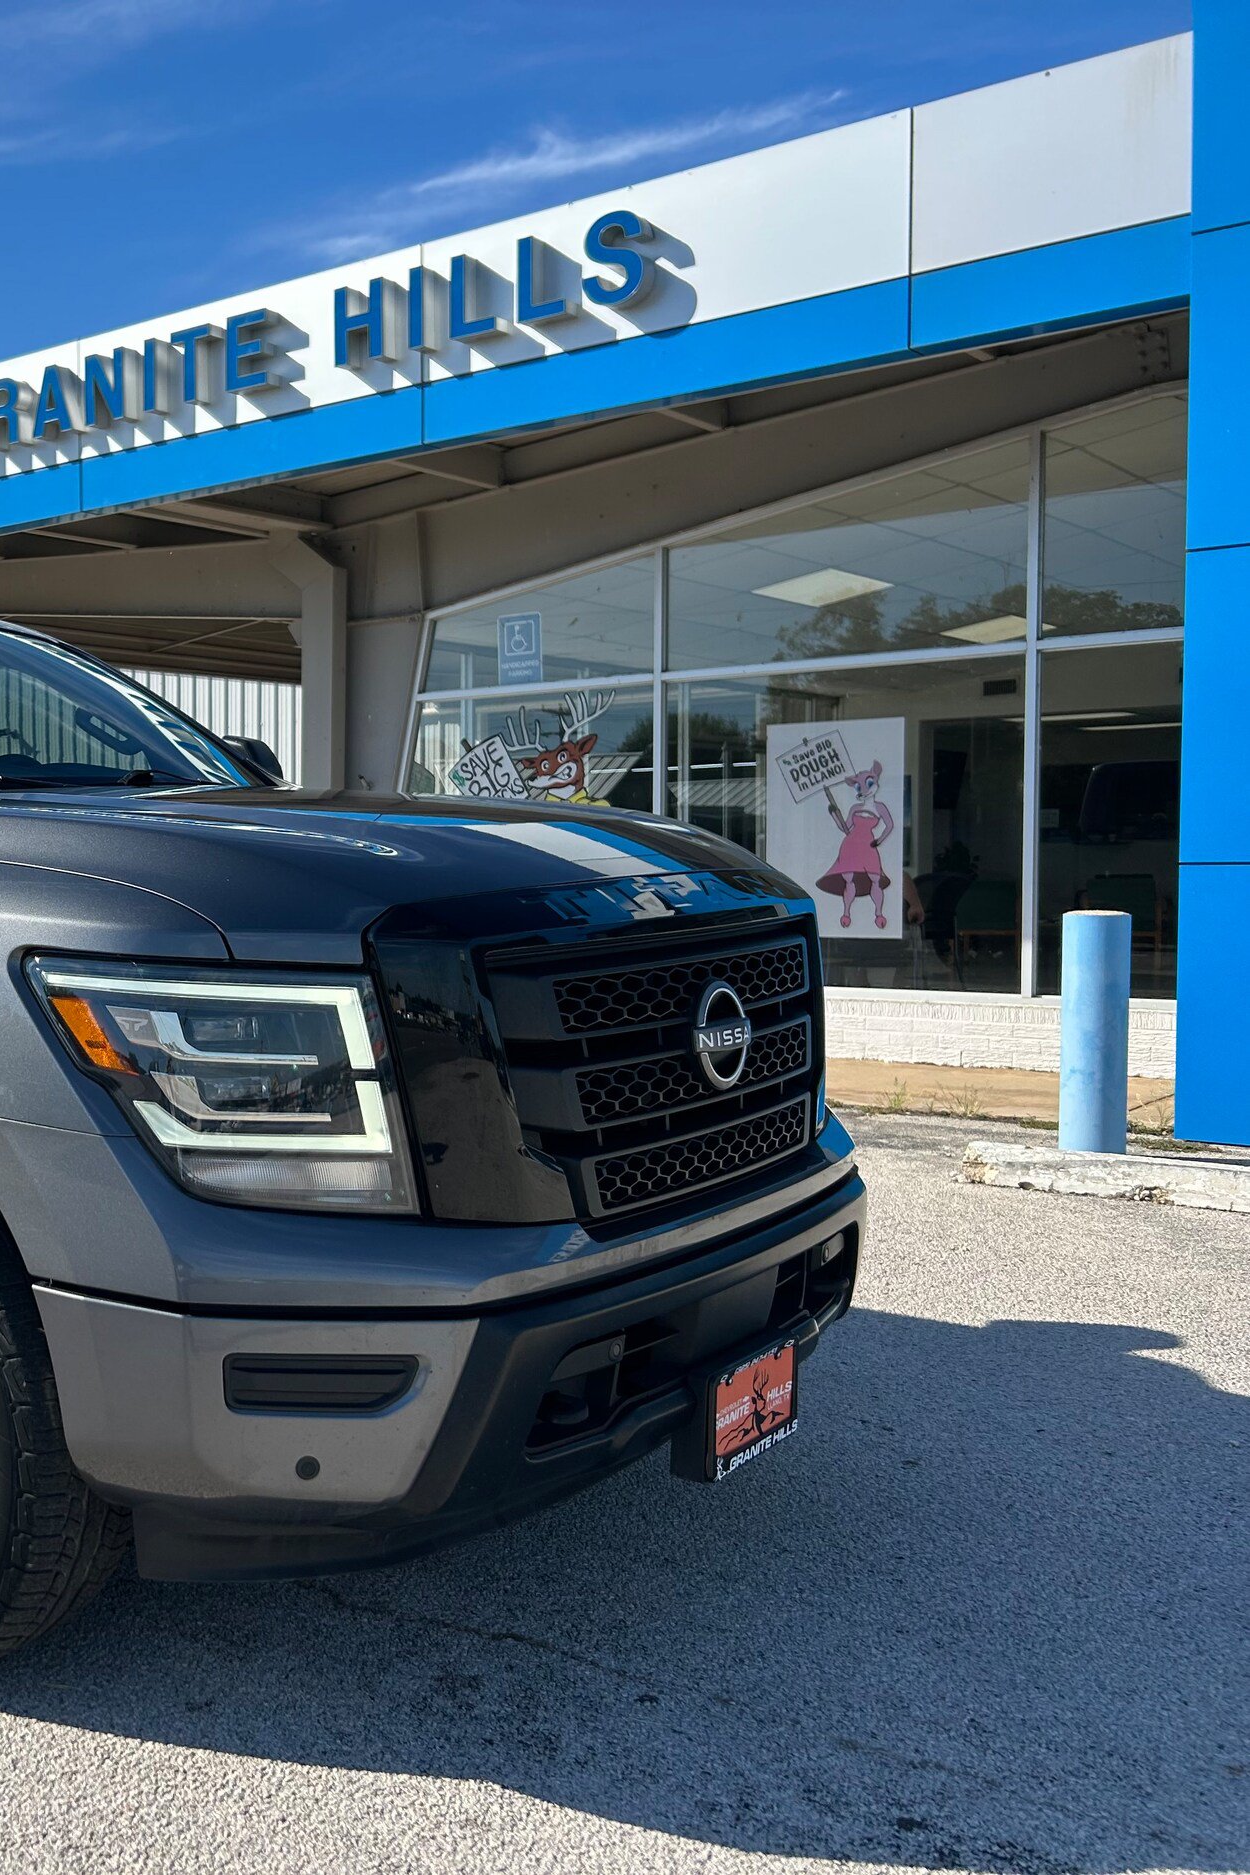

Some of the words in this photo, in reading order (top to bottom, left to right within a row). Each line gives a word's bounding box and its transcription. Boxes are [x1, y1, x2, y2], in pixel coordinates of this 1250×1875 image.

[334, 209, 647, 369] HILLS
[789, 748, 841, 783] DOUGH
[792, 749, 815, 764] Save
[798, 781, 809, 792] in
[808, 762, 846, 786] LLANO!
[698, 1026, 750, 1049] NISSA
[766, 1381, 793, 1403] HILLS
[730, 1434, 772, 1471] GRANITE
[773, 1419, 798, 1446] HILLS
